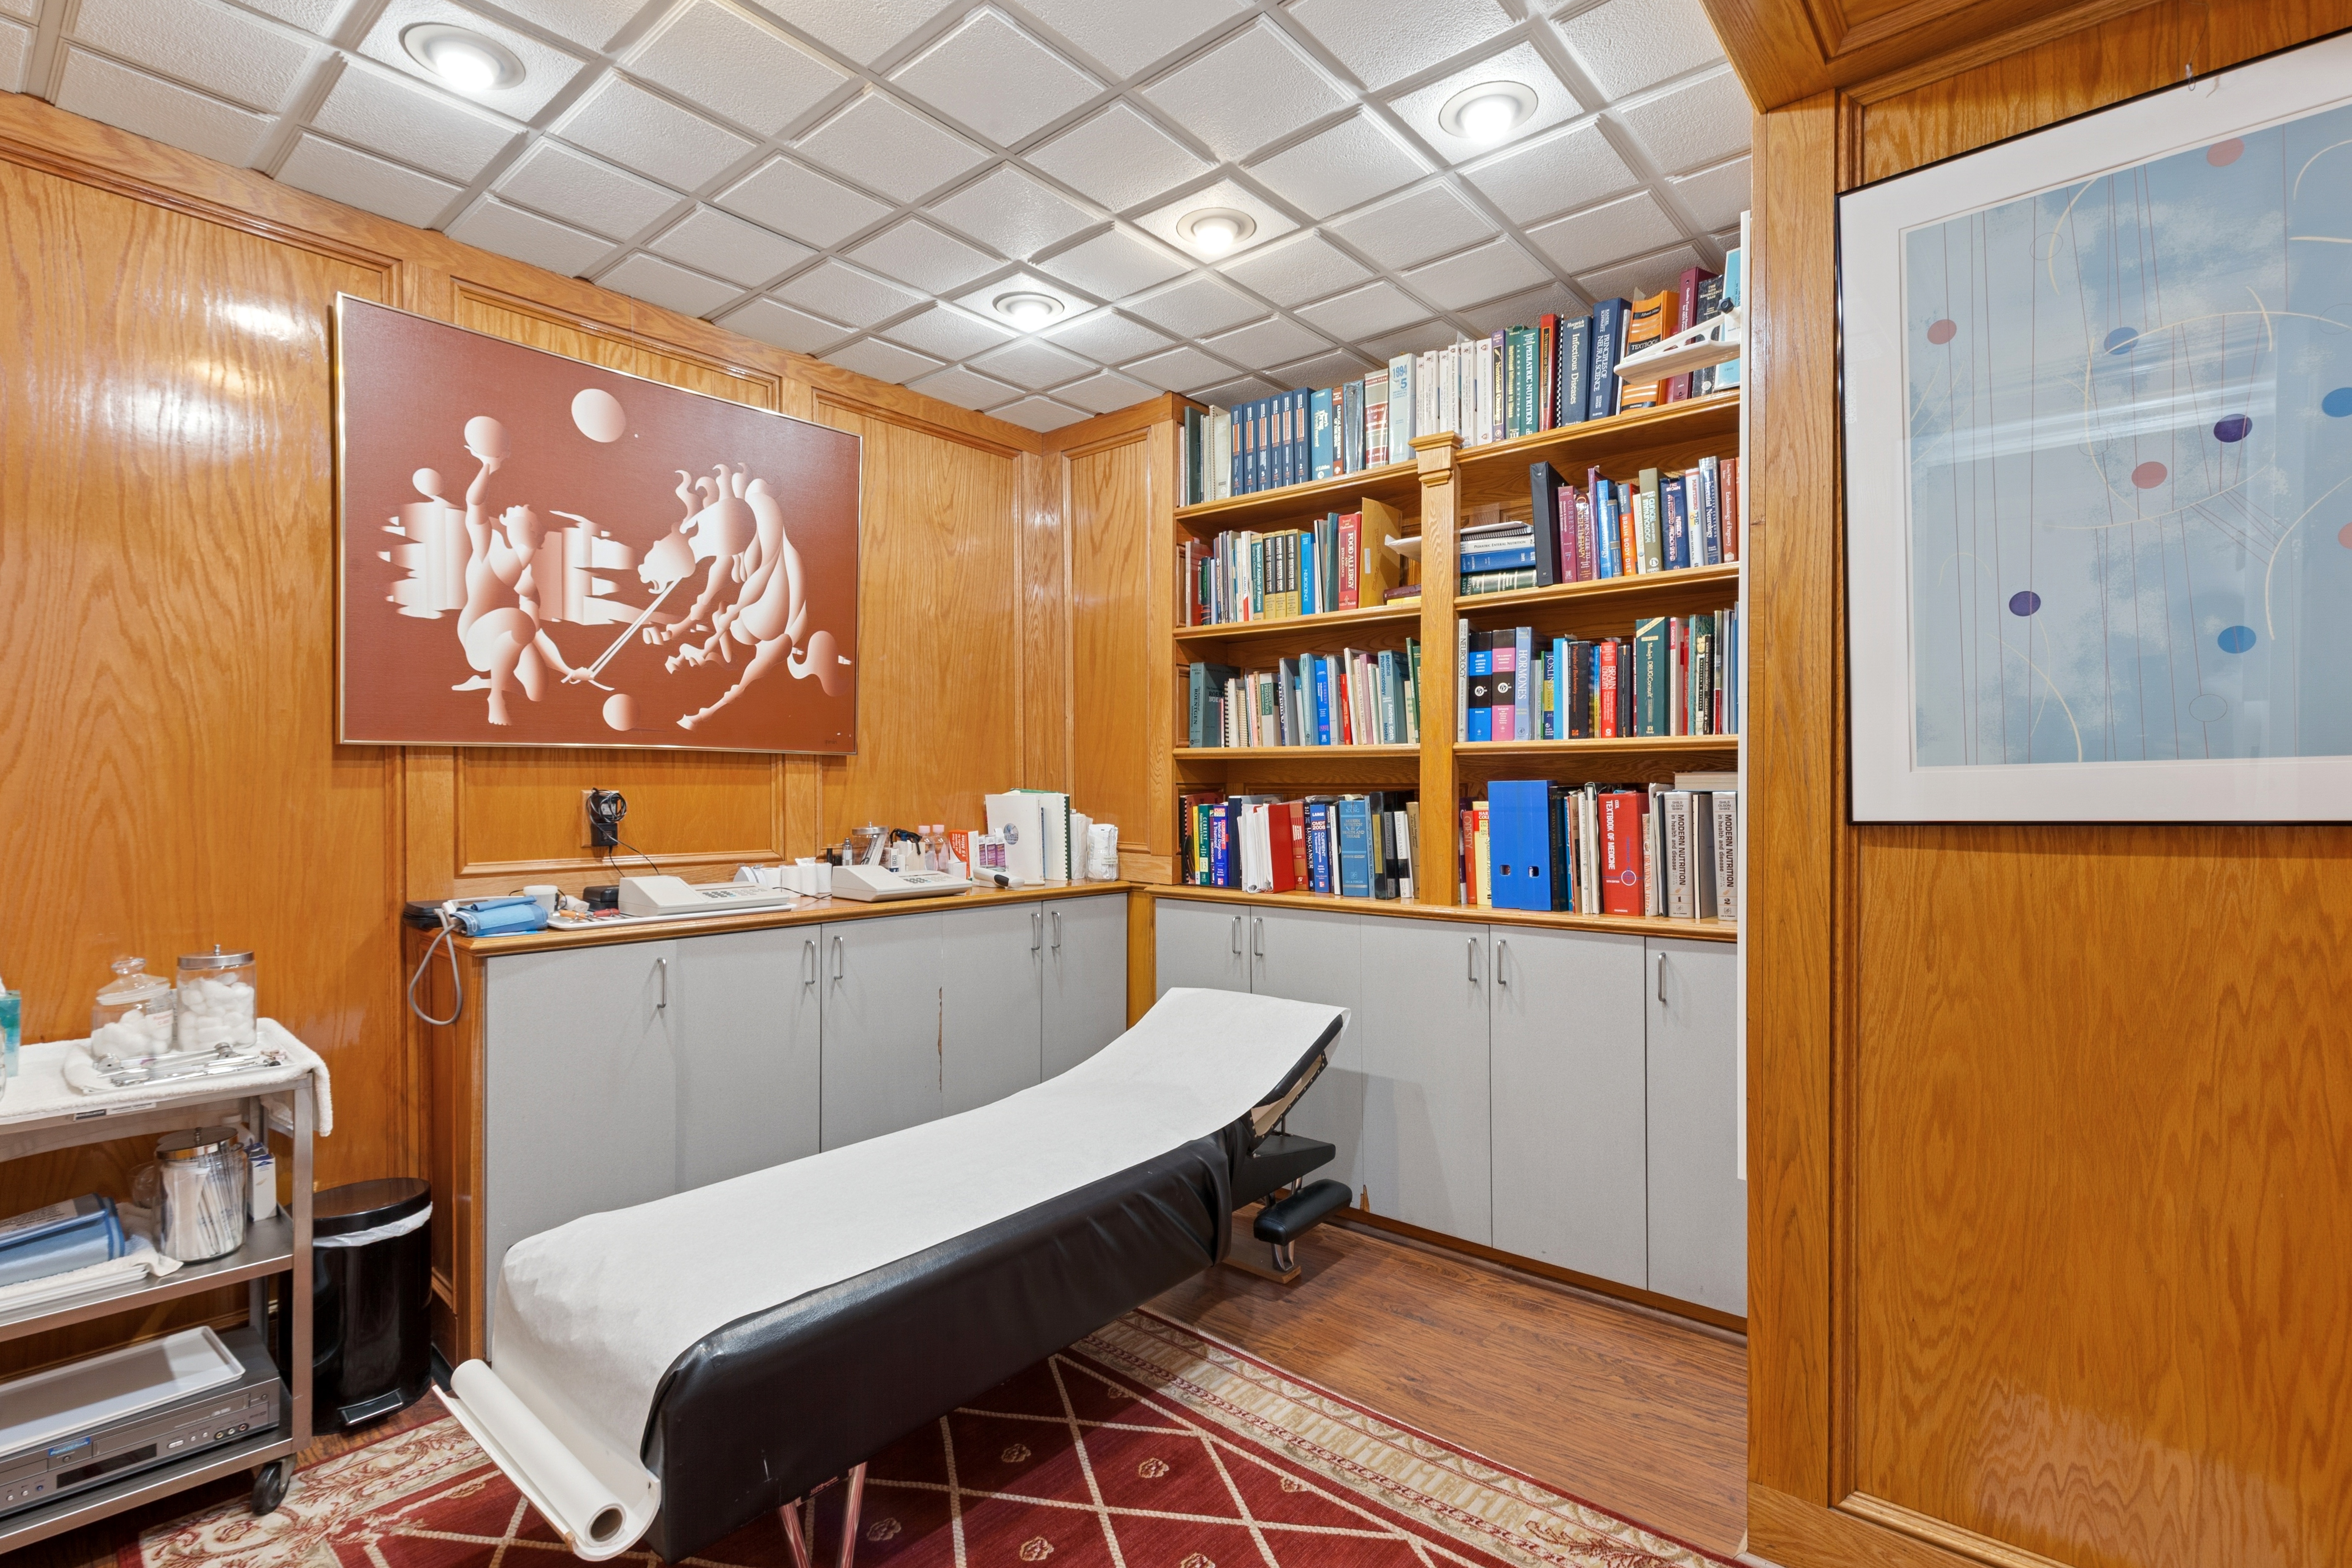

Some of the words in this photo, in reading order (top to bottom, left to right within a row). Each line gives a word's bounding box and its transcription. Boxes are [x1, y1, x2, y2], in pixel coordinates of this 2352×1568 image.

[1700, 289, 1723, 299] KNOWLEDGE
[1567, 320, 1584, 328] Hoeprich
[1571, 333, 1580, 371] Infectious
[1596, 335, 1604, 365] NEURAL
[1602, 334, 1610, 370] PRINCIPLES
[1631, 338, 1660, 351] TEXTBOOK
[1393, 365, 1407, 379] 1994
[1601, 370, 1607, 379] OF
[1570, 372, 1579, 405] Diseases
[1518, 650, 1528, 700] HORMONES
[1545, 655, 1554, 689] JOSLIN'S
[1608, 666, 1616, 689] BRAIN
[1464, 816, 1473, 848] OBESITY
